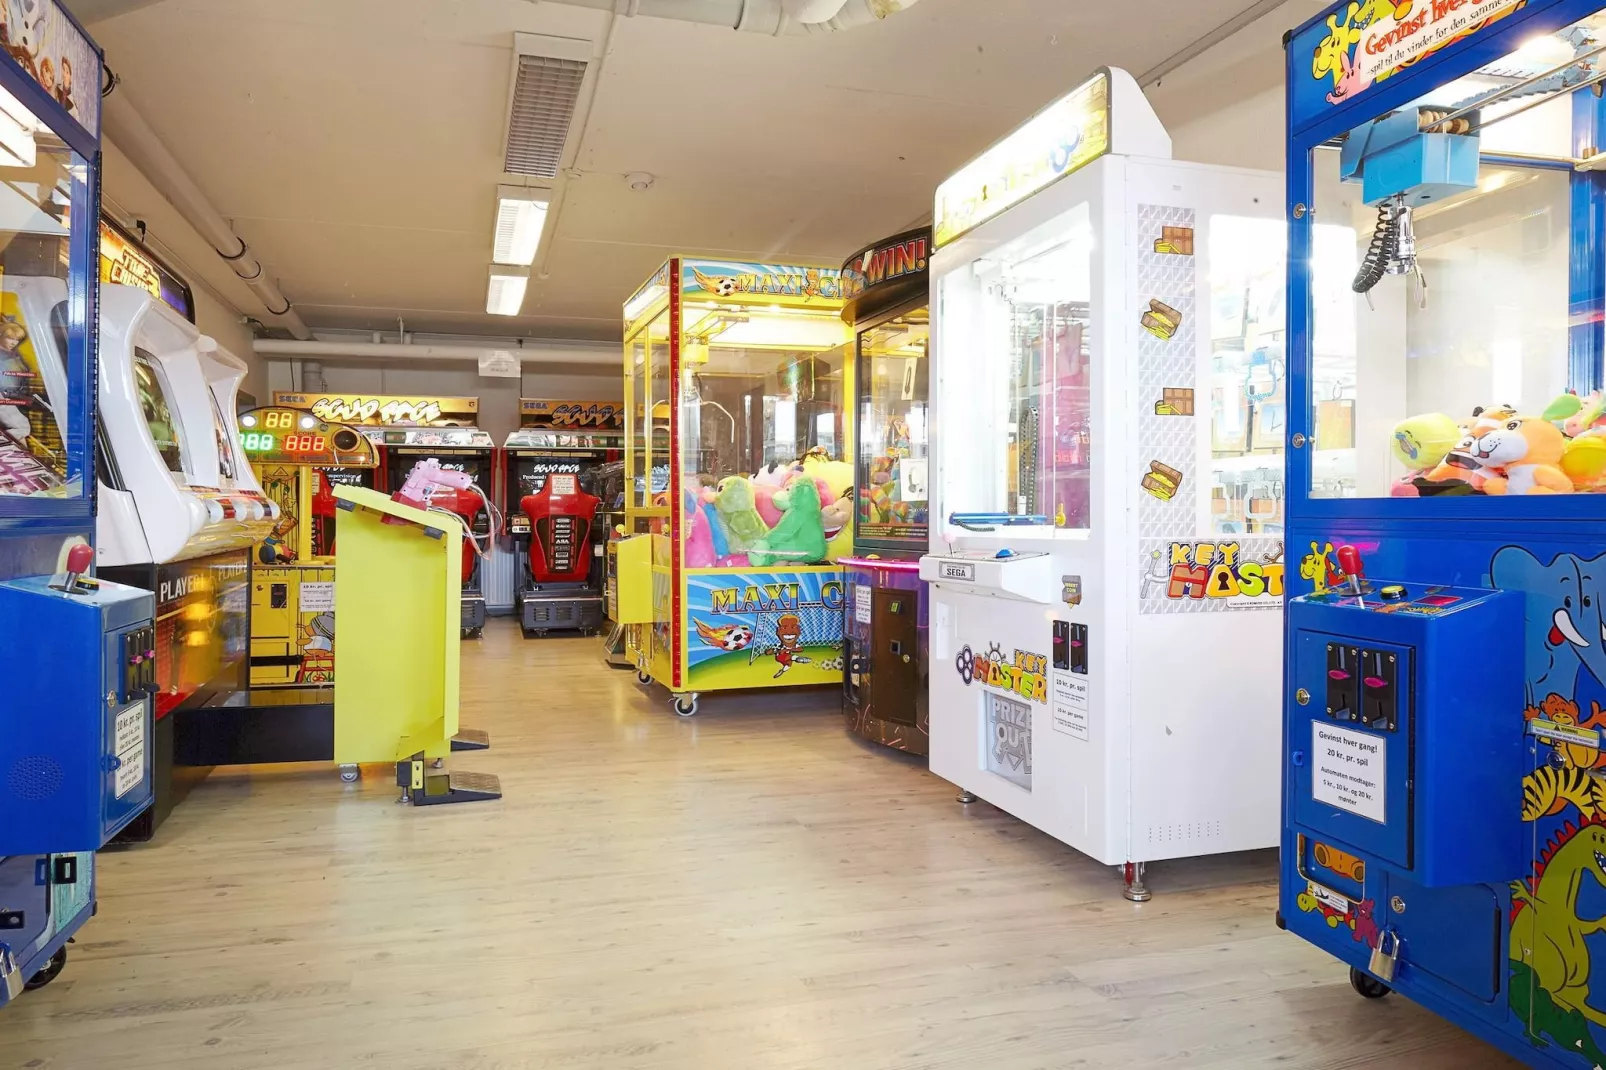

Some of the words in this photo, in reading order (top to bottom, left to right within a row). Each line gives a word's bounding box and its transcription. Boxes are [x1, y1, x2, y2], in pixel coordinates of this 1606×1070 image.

[1365, 7, 1429, 56] Gevinst
[1394, 48, 1405, 61] du
[1407, 35, 1434, 53] vinder
[1435, 27, 1449, 40] for
[1450, 17, 1467, 31] den
[122, 248, 151, 279] TIME
[867, 236, 928, 284] WIN!
[737, 272, 804, 296] MAXI
[311, 397, 380, 422] SCUD
[380, 400, 442, 424] RACE
[1169, 541, 1240, 566] KEY
[946, 568, 966, 577] SEGA
[1167, 562, 1284, 599] MAST
[160, 574, 200, 603] PLAYER
[710, 582, 801, 616] MAXI
[1014, 649, 1048, 676] KEY
[973, 653, 1047, 705] MASTER
[117, 720, 123, 732] 10
[1319, 731, 1342, 744] Gevinst
[1343, 737, 1358, 747] hver
[1359, 742, 1378, 753] gang!
[1327, 748, 1335, 756] 20
[1336, 751, 1345, 760] kr.
[1346, 755, 1355, 763] pr.
[1356, 758, 1368, 766] spil
[1321, 766, 1348, 779] Automaten
[1349, 775, 1376, 788] modtager:
[1338, 795, 1357, 806] mønter
